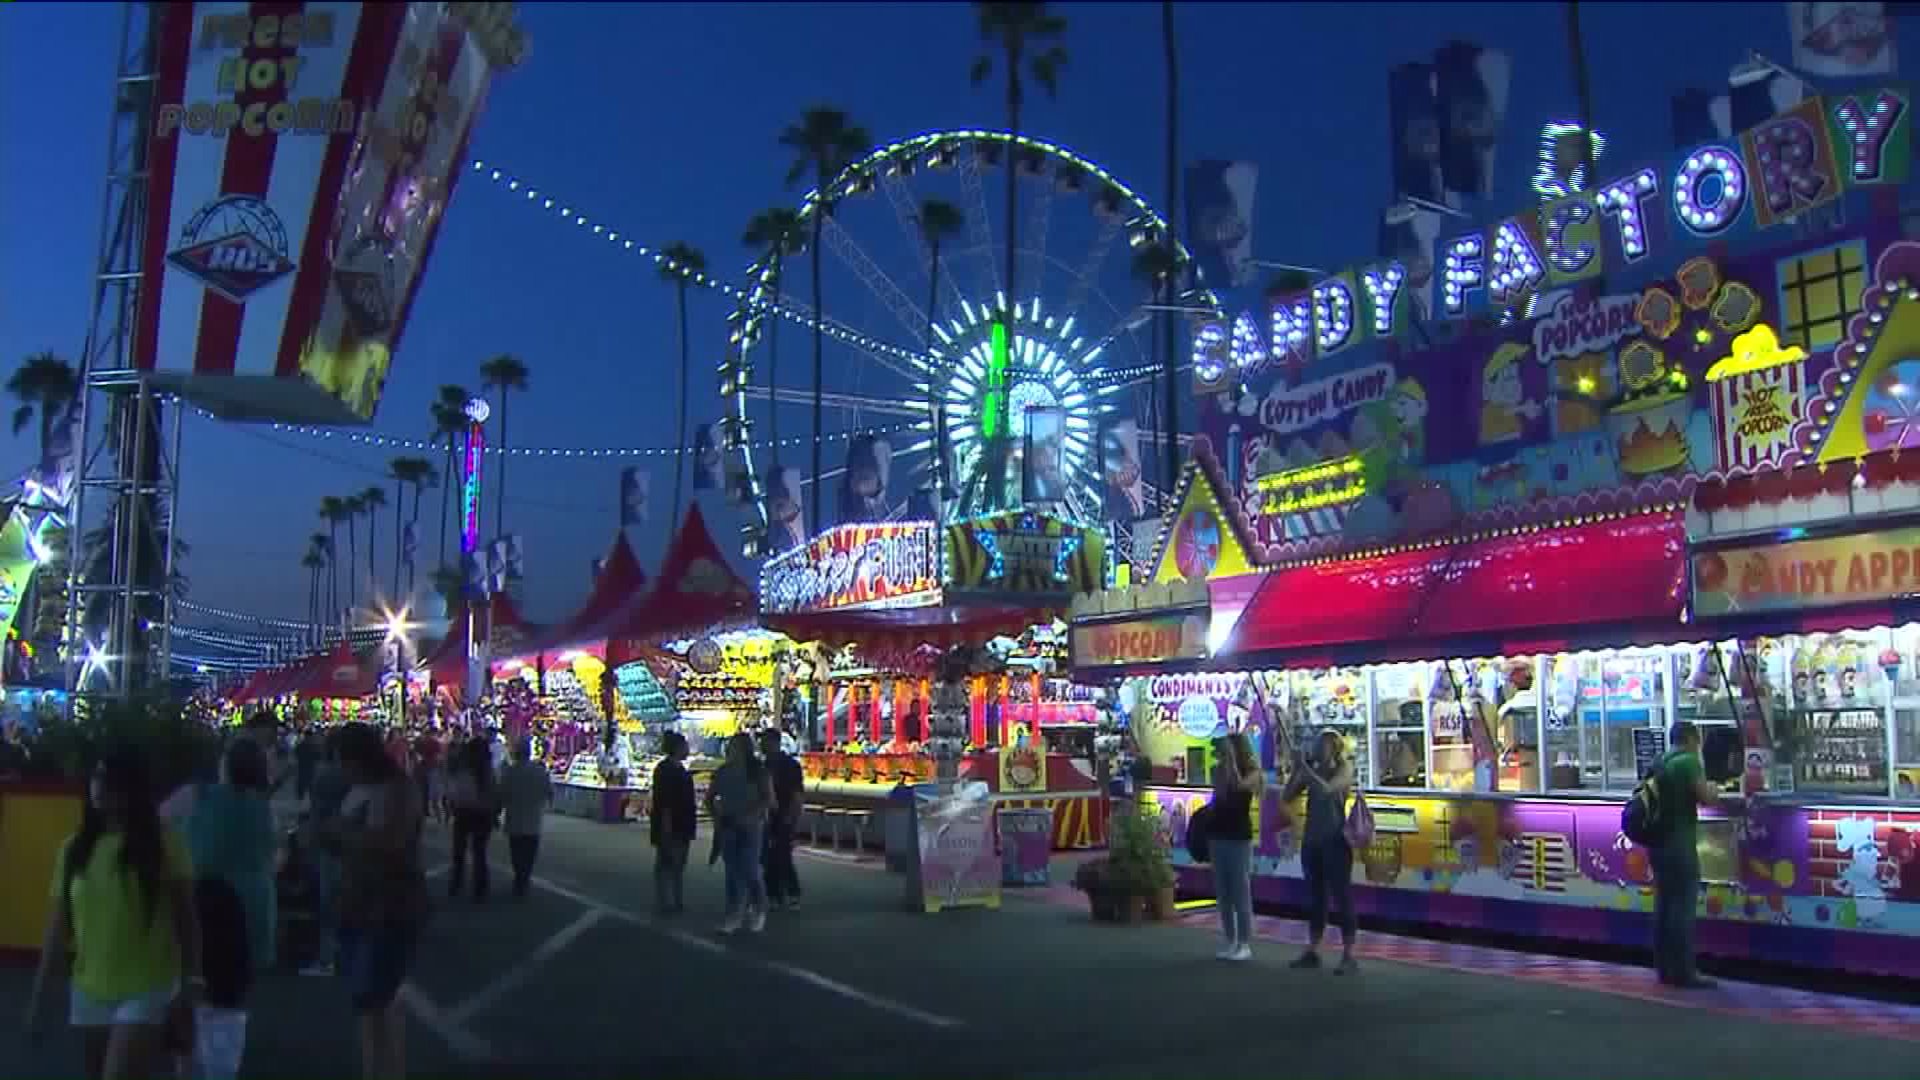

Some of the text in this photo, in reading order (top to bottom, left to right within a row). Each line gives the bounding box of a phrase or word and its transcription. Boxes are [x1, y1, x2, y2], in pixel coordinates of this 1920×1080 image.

[217, 56, 306, 94] HOT
[156, 99, 353, 137] POPCORN
[1192, 92, 1908, 386] CANDY FACTORY
[1541, 300, 1636, 354] POPCORN
